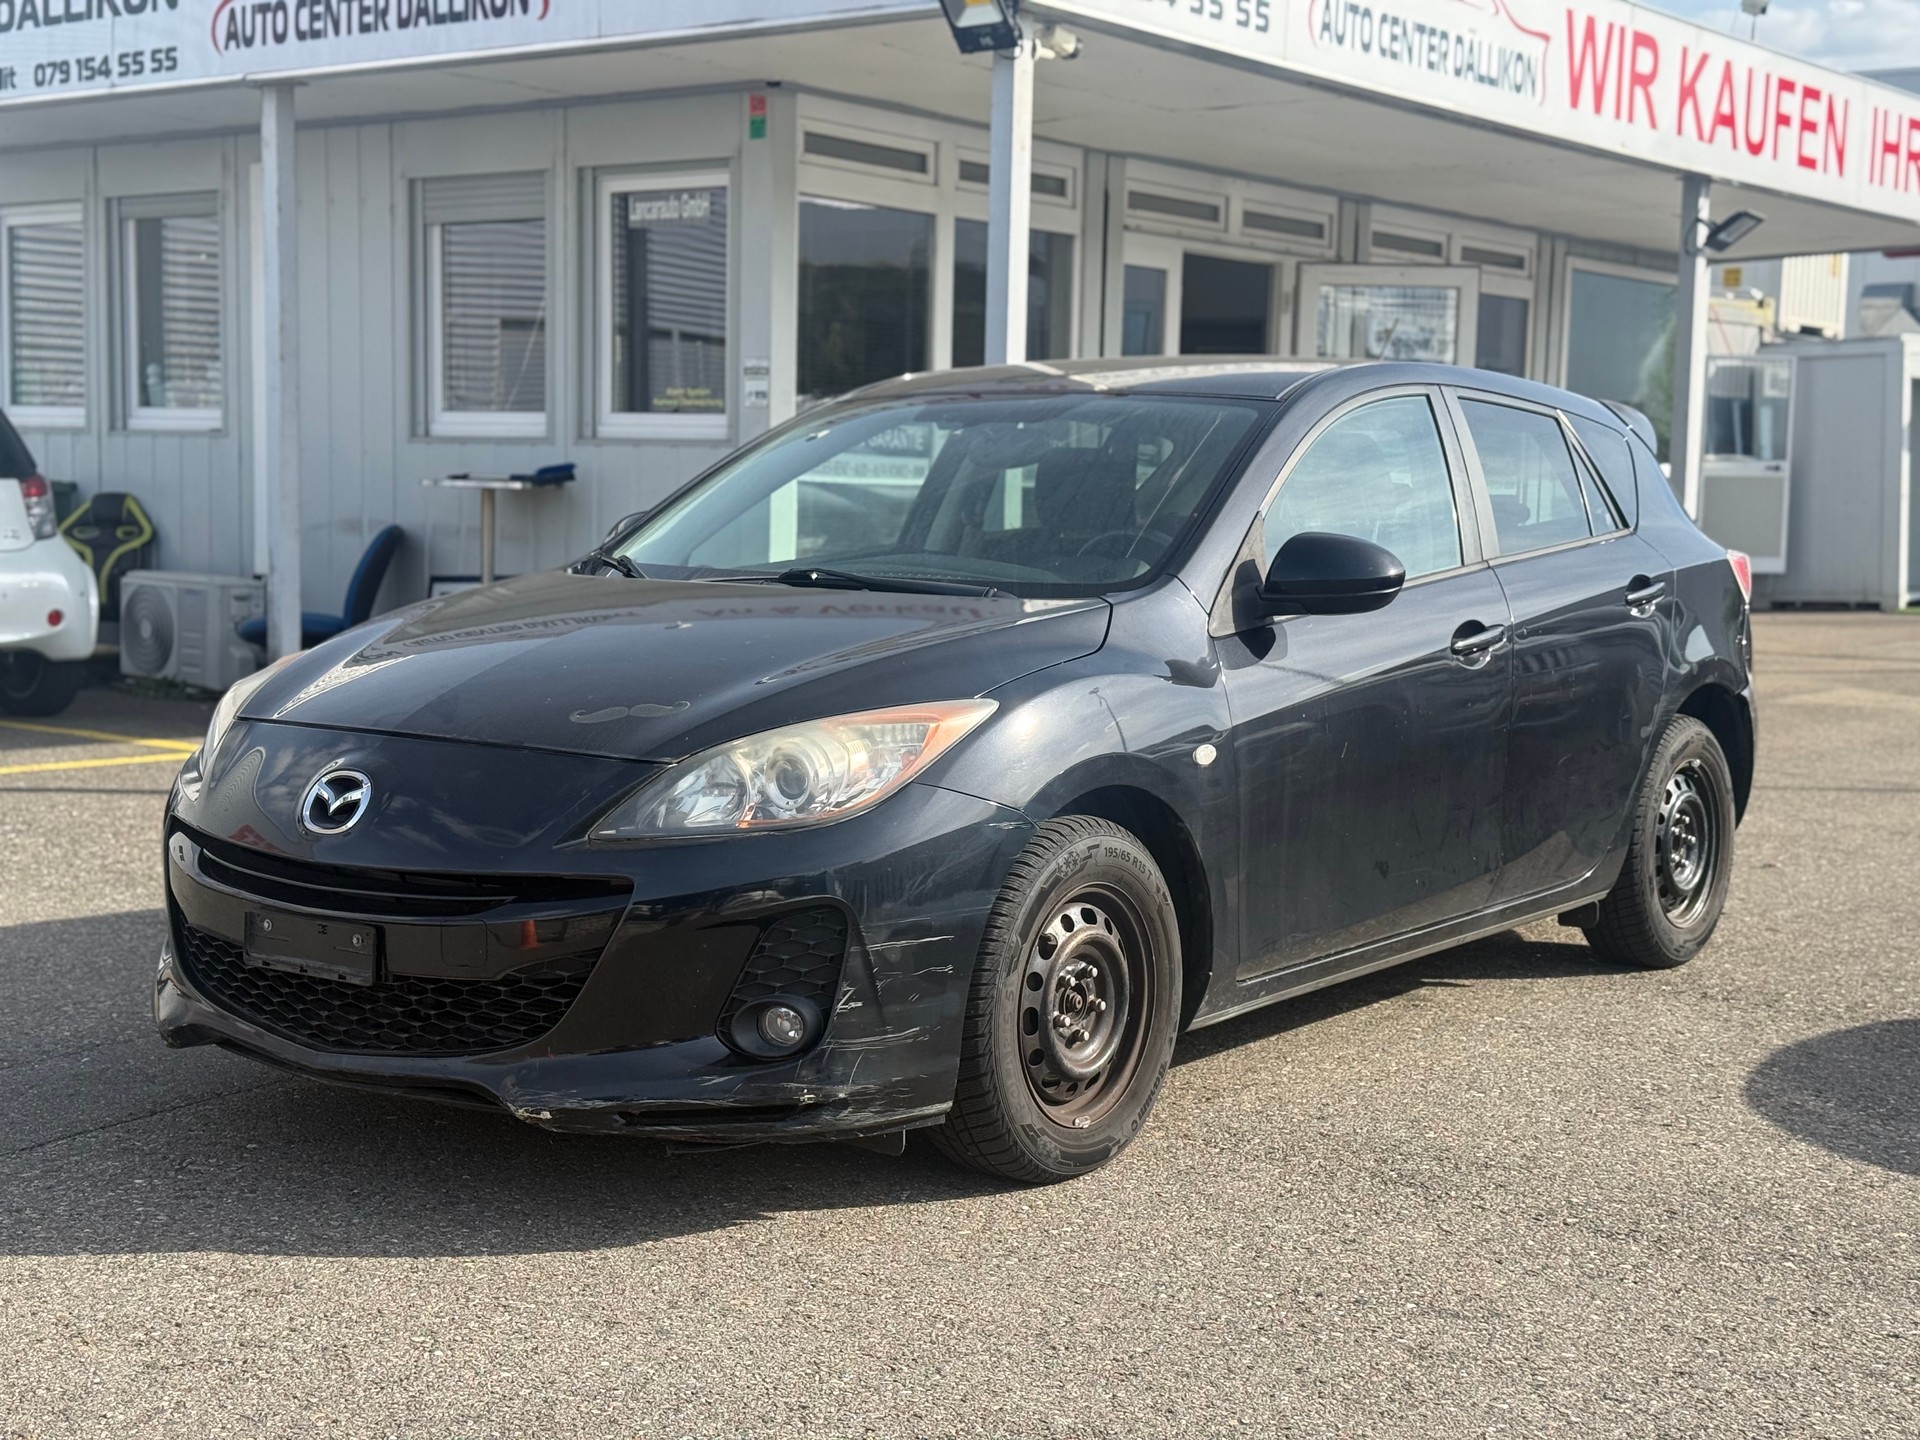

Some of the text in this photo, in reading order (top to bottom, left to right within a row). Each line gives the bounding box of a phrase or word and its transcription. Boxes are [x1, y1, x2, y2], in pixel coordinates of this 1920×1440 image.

[224, 0, 288, 51] AUTO
[294, 0, 389, 41] CENTER
[1236, 0, 1269, 33] 55
[34, 60, 70, 87] 079
[76, 55, 111, 82] 154
[118, 51, 144, 78] 55
[151, 46, 177, 73] 55
[1320, 0, 1538, 97] AUTO CENTER DÄLLIKON
[1566, 9, 1657, 130] WIR
[1677, 46, 1849, 178] KAUFEN
[1104, 847, 1154, 881] 195/65 R15 T
